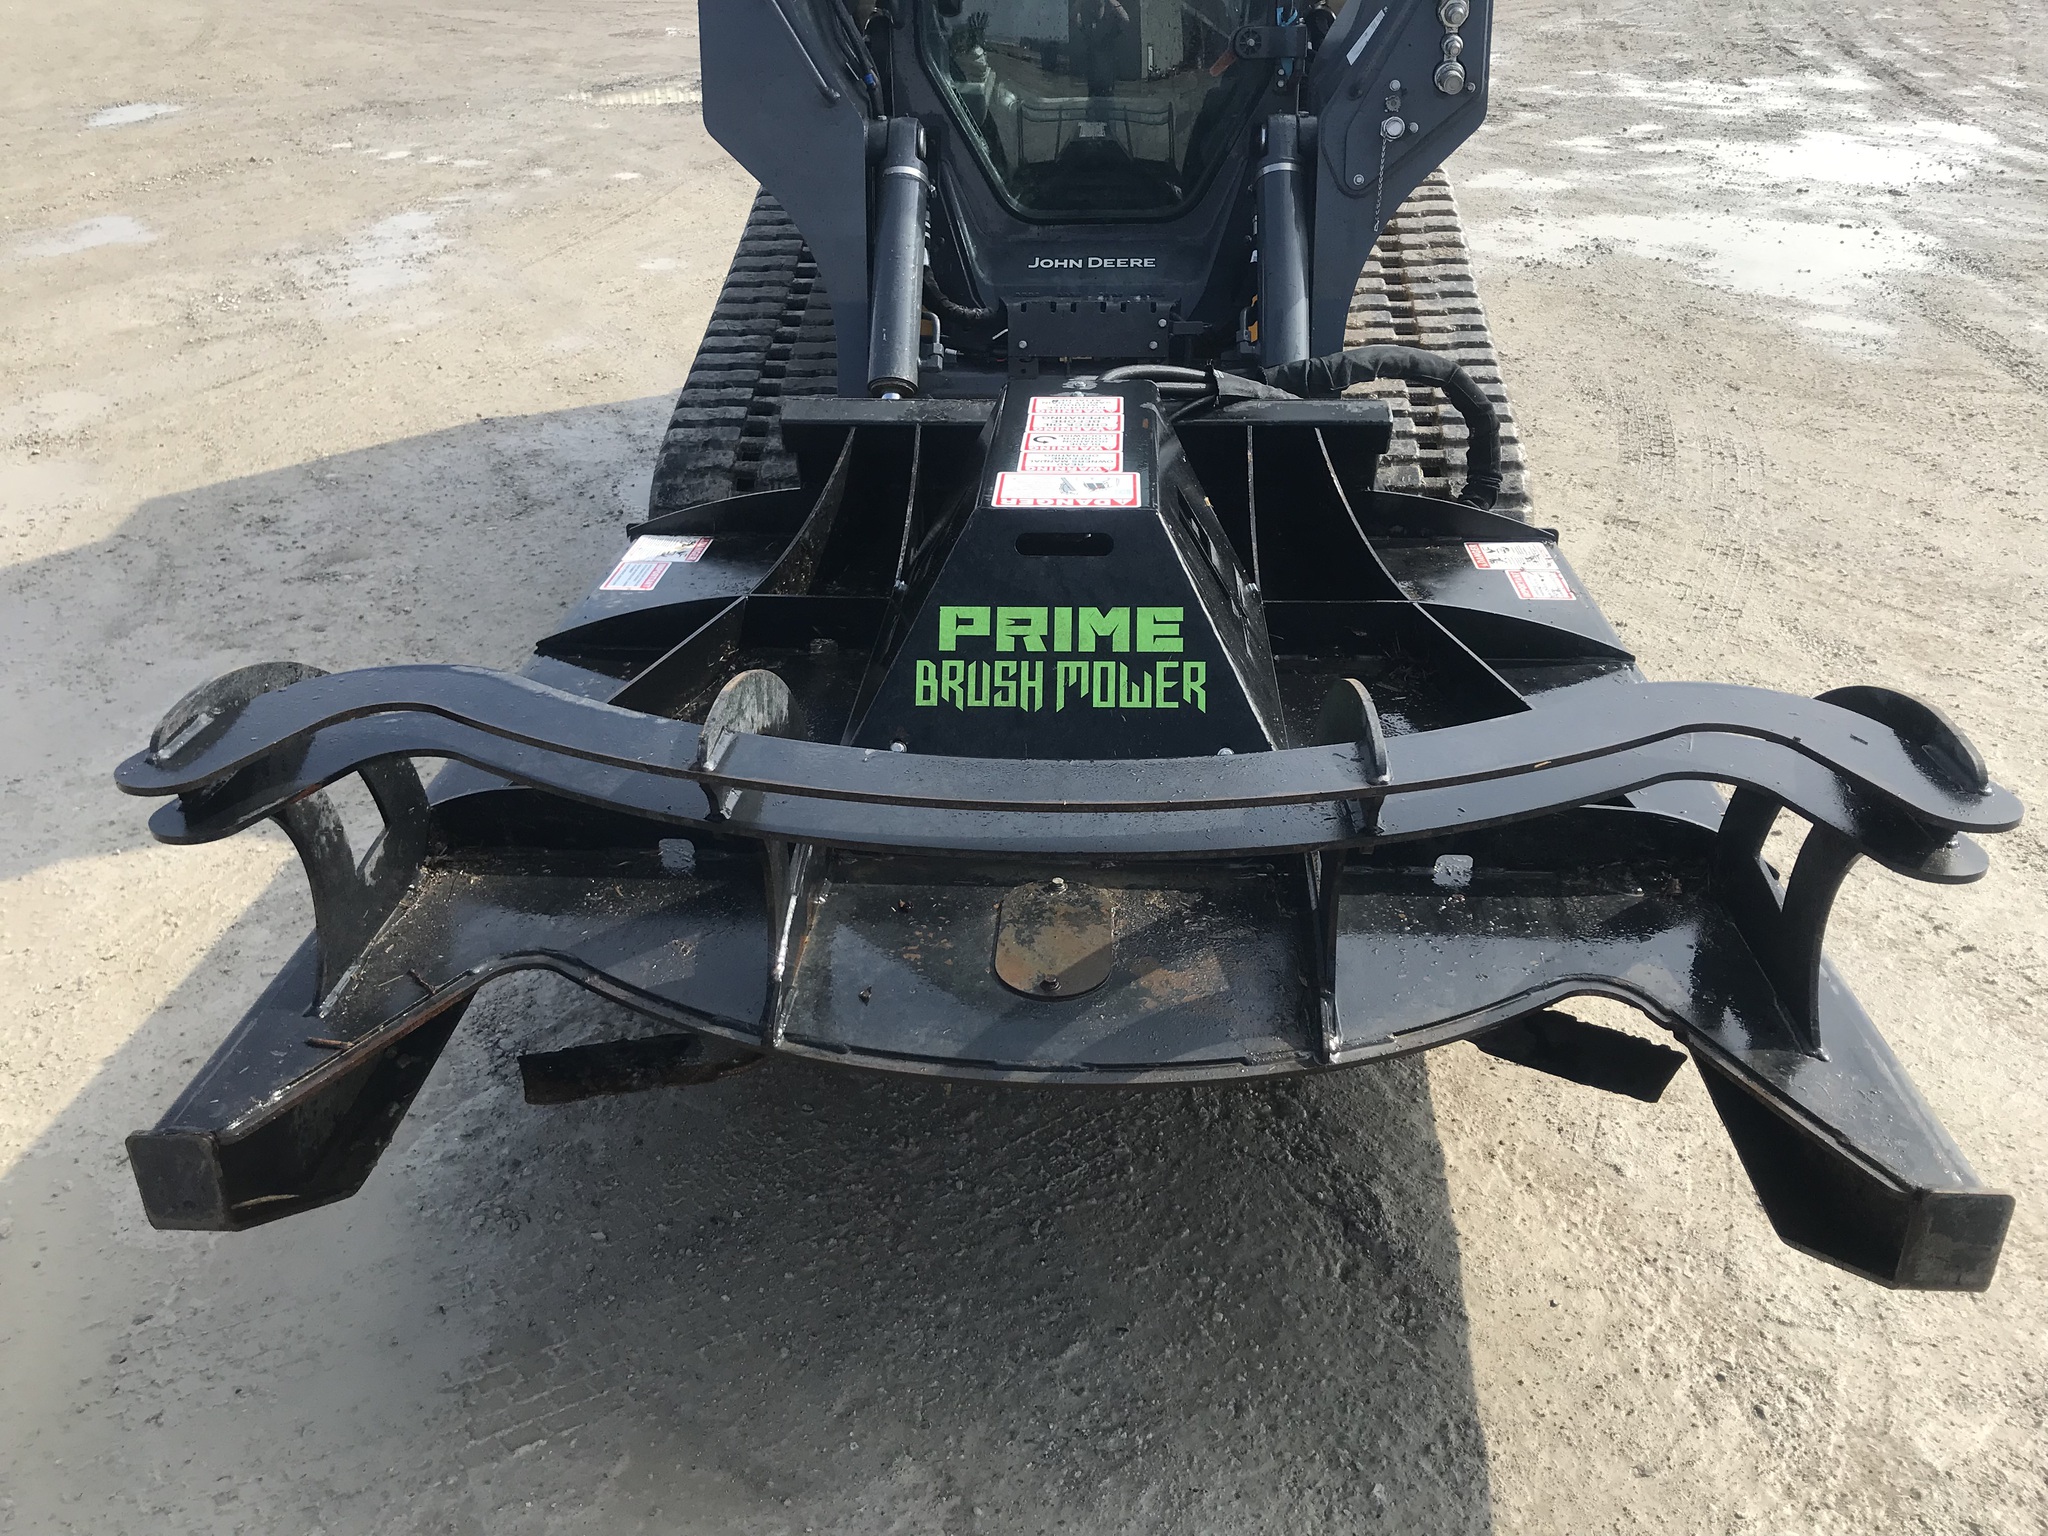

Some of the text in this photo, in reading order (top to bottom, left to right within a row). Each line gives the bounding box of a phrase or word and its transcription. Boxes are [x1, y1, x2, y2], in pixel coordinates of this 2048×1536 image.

[1028, 257, 1156, 269] JOHN DEERE
[1000, 498, 1111, 506] DANGER
[938, 606, 1184, 653] PRIME
[915, 659, 1207, 714] BRUSH MOWER
